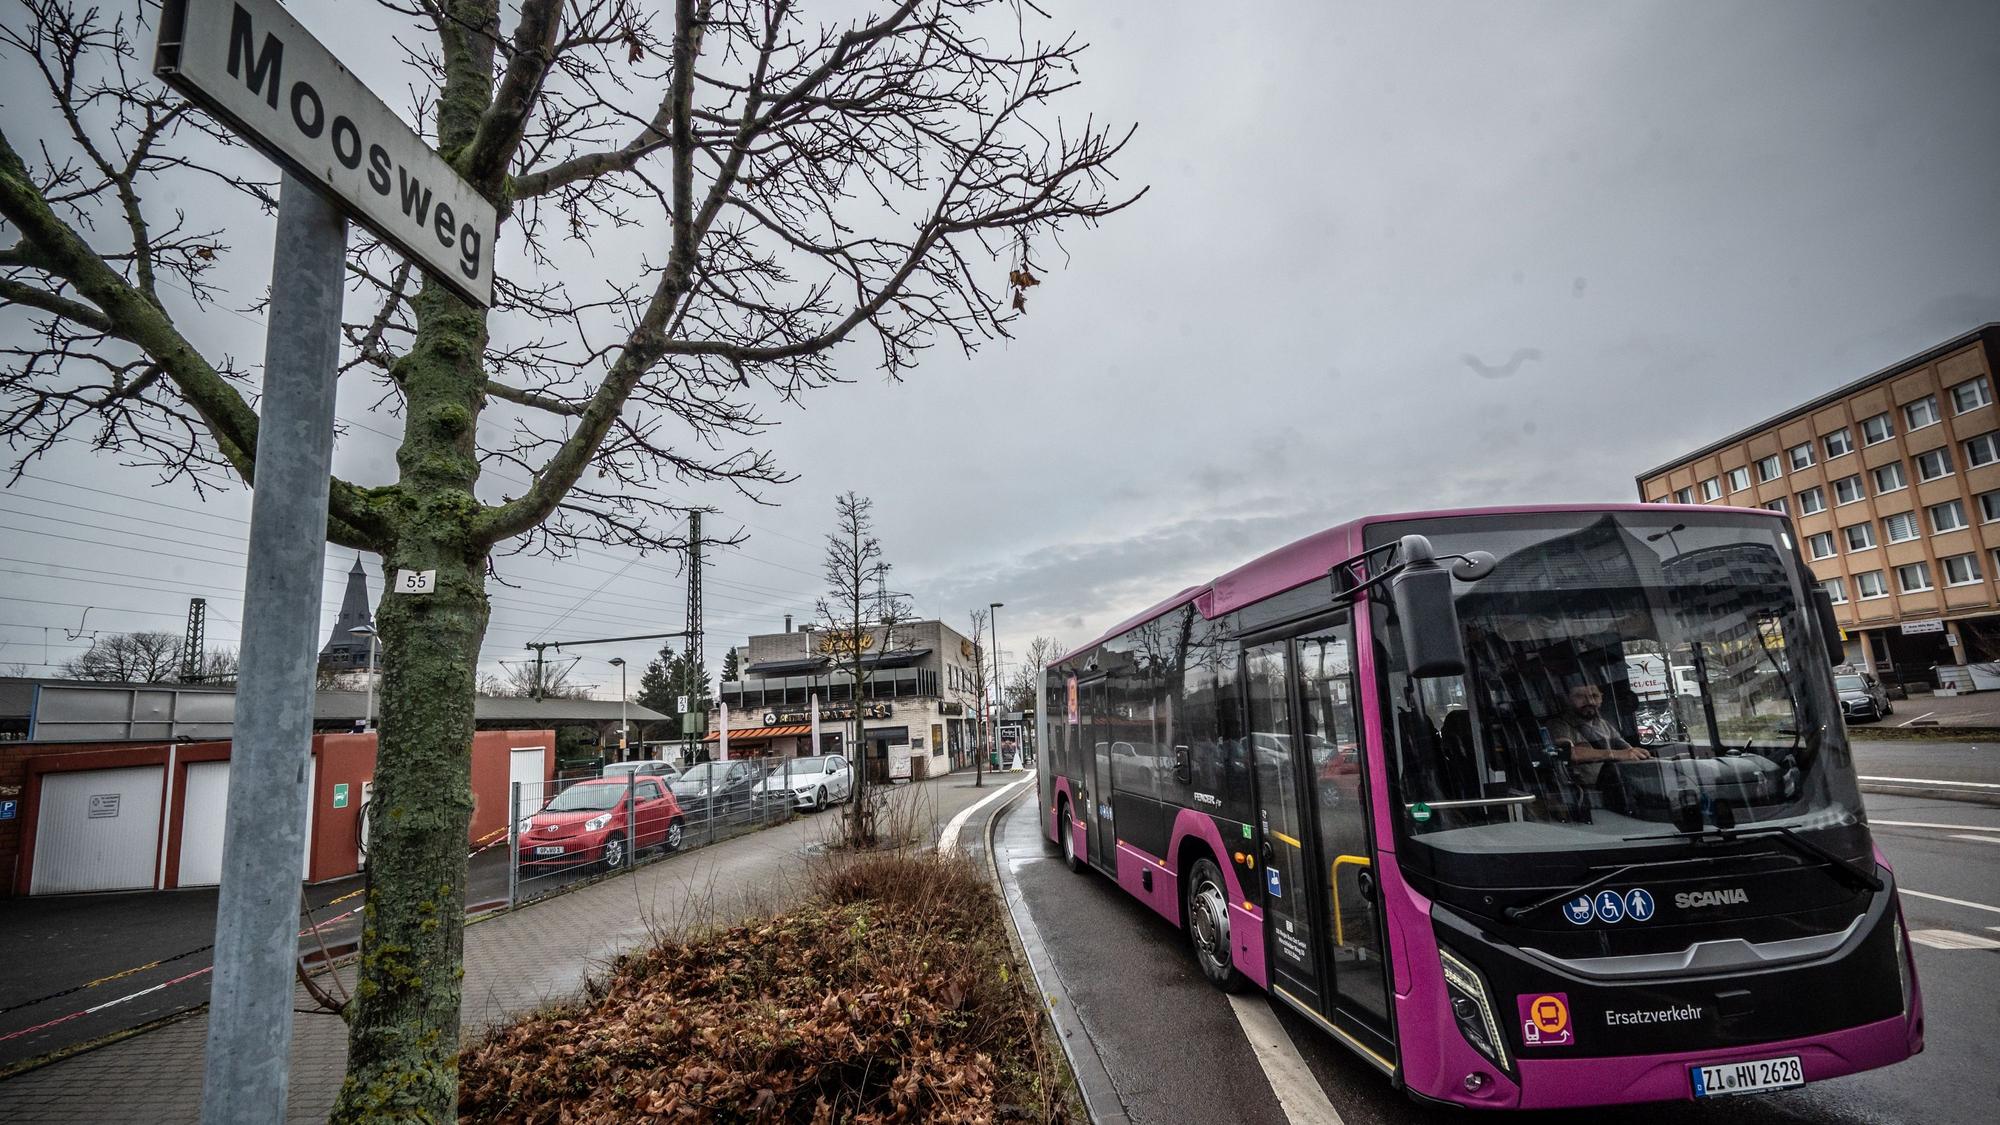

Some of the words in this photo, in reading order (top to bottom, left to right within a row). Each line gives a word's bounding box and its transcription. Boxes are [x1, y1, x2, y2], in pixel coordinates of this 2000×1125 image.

[227, 2, 481, 281] Moosweg
[406, 575, 426, 588] 55
[4, 802, 13, 811] P
[1675, 888, 1749, 908] SCANIA
[1605, 1004, 1702, 1025] Ersatzverkehr
[1703, 1068, 1725, 1091] ZI
[1735, 1064, 1757, 1088] HV
[1760, 1060, 1800, 1085] 2628
